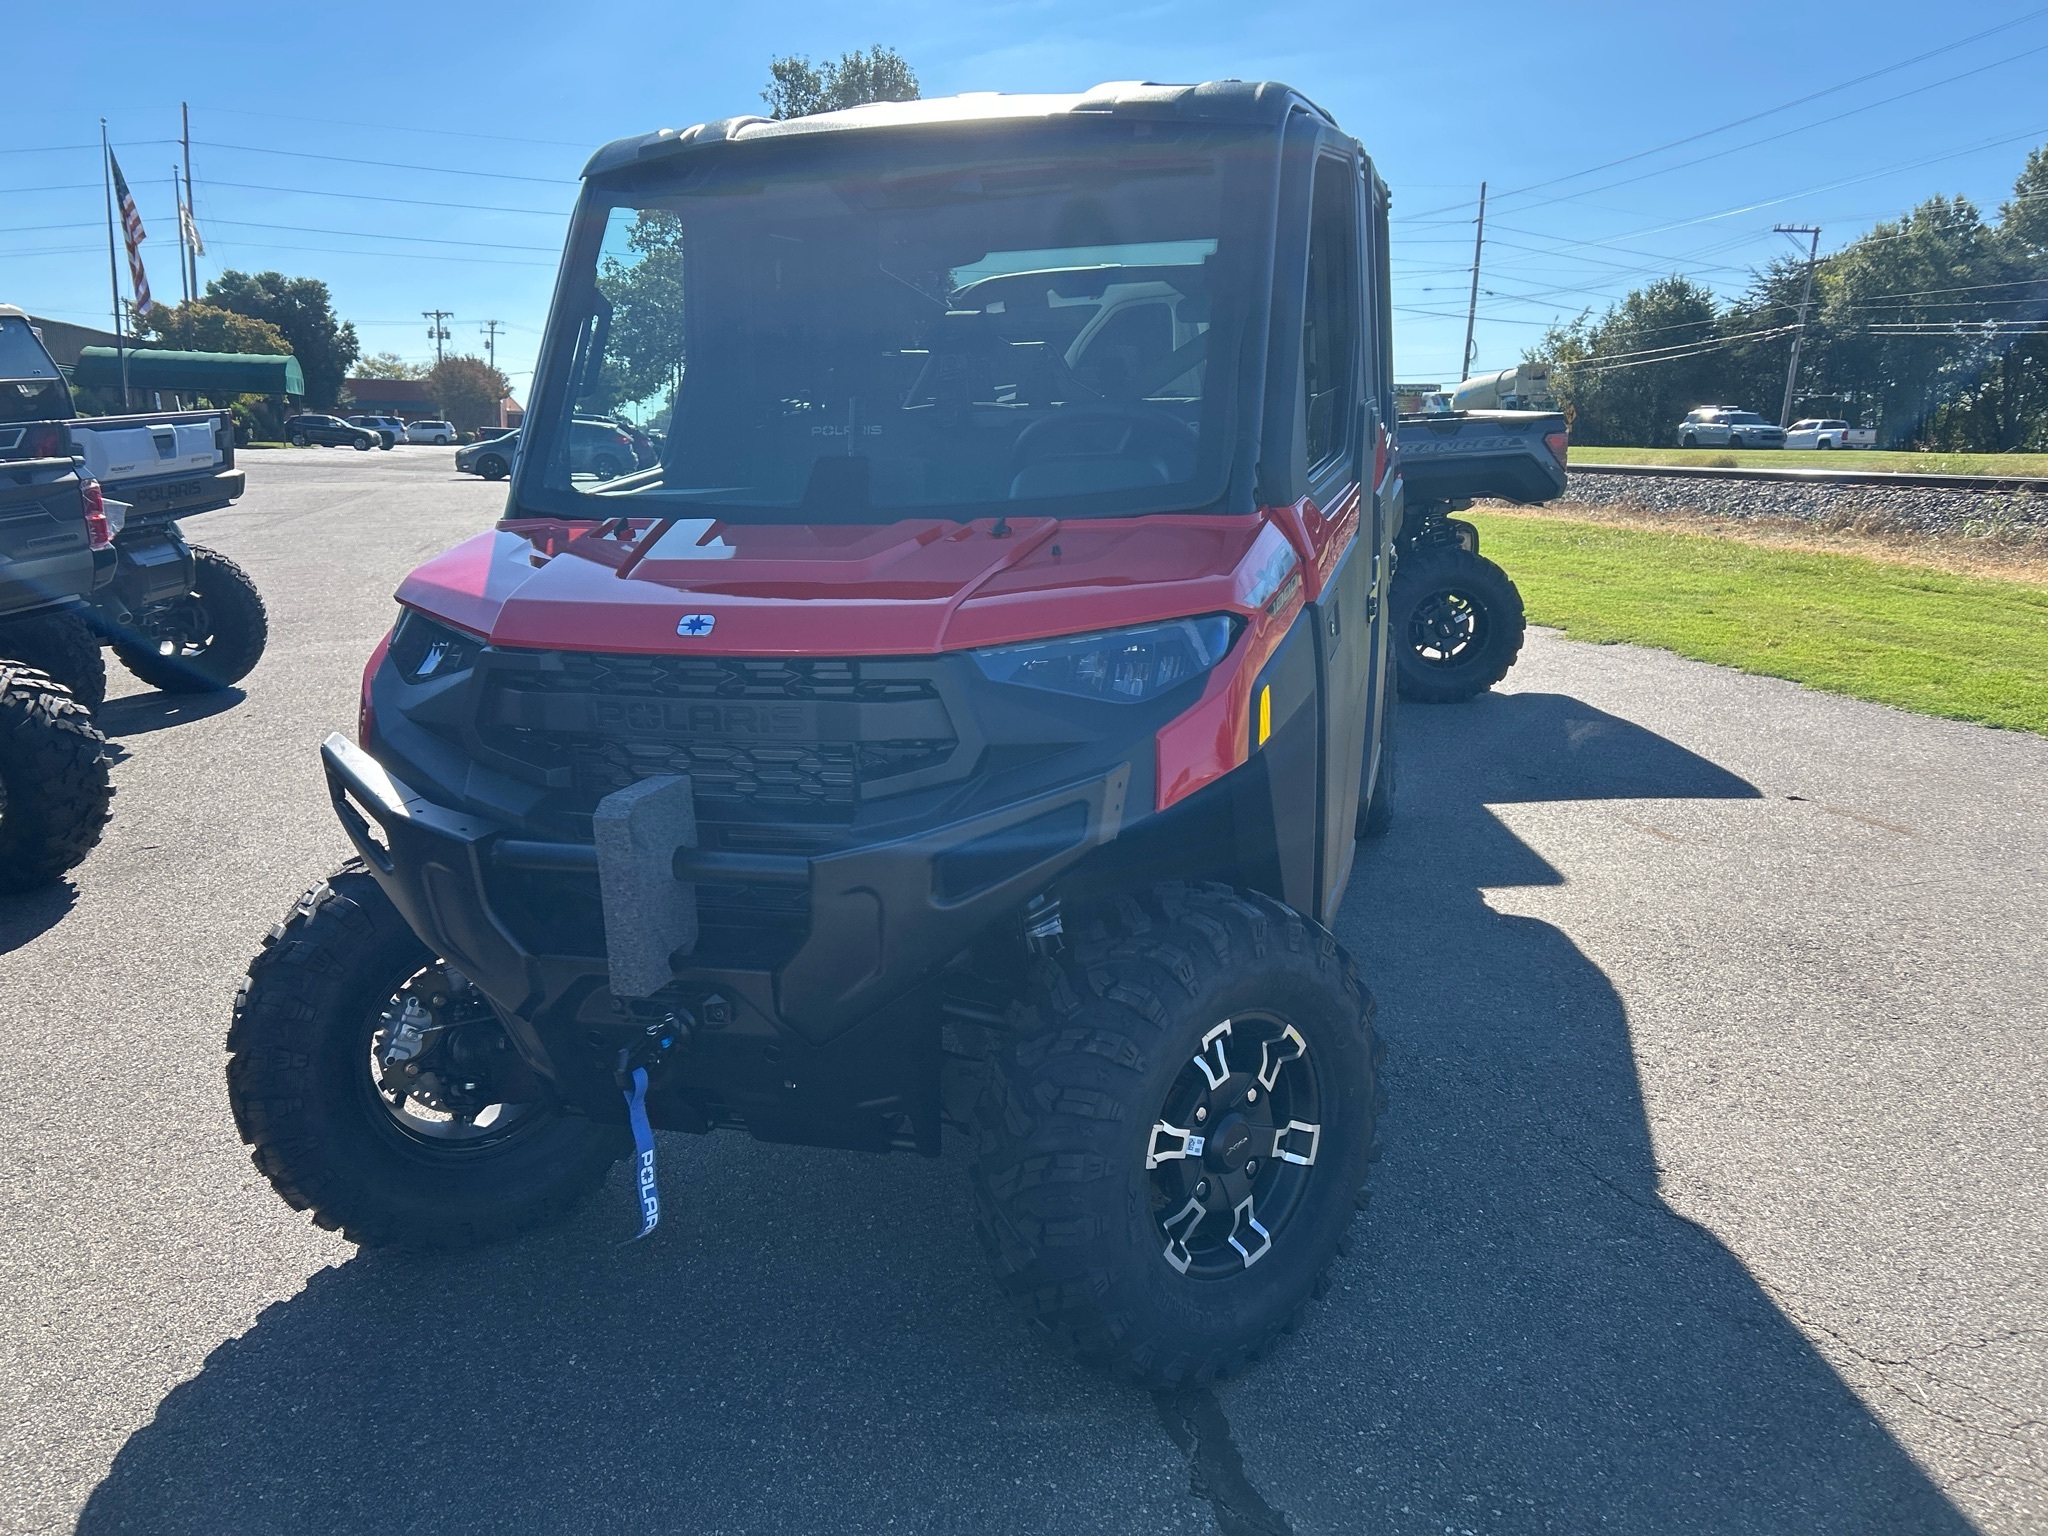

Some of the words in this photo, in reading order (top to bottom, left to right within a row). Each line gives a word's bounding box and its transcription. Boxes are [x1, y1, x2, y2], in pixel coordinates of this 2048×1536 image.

[811, 425, 883, 436] POLAIS
[1401, 436, 1510, 454] RANGER
[137, 480, 202, 501] POLARIS
[1271, 571, 1300, 614] 1000
[594, 702, 804, 734] POLARIS
[640, 1149, 659, 1233] POLAR
